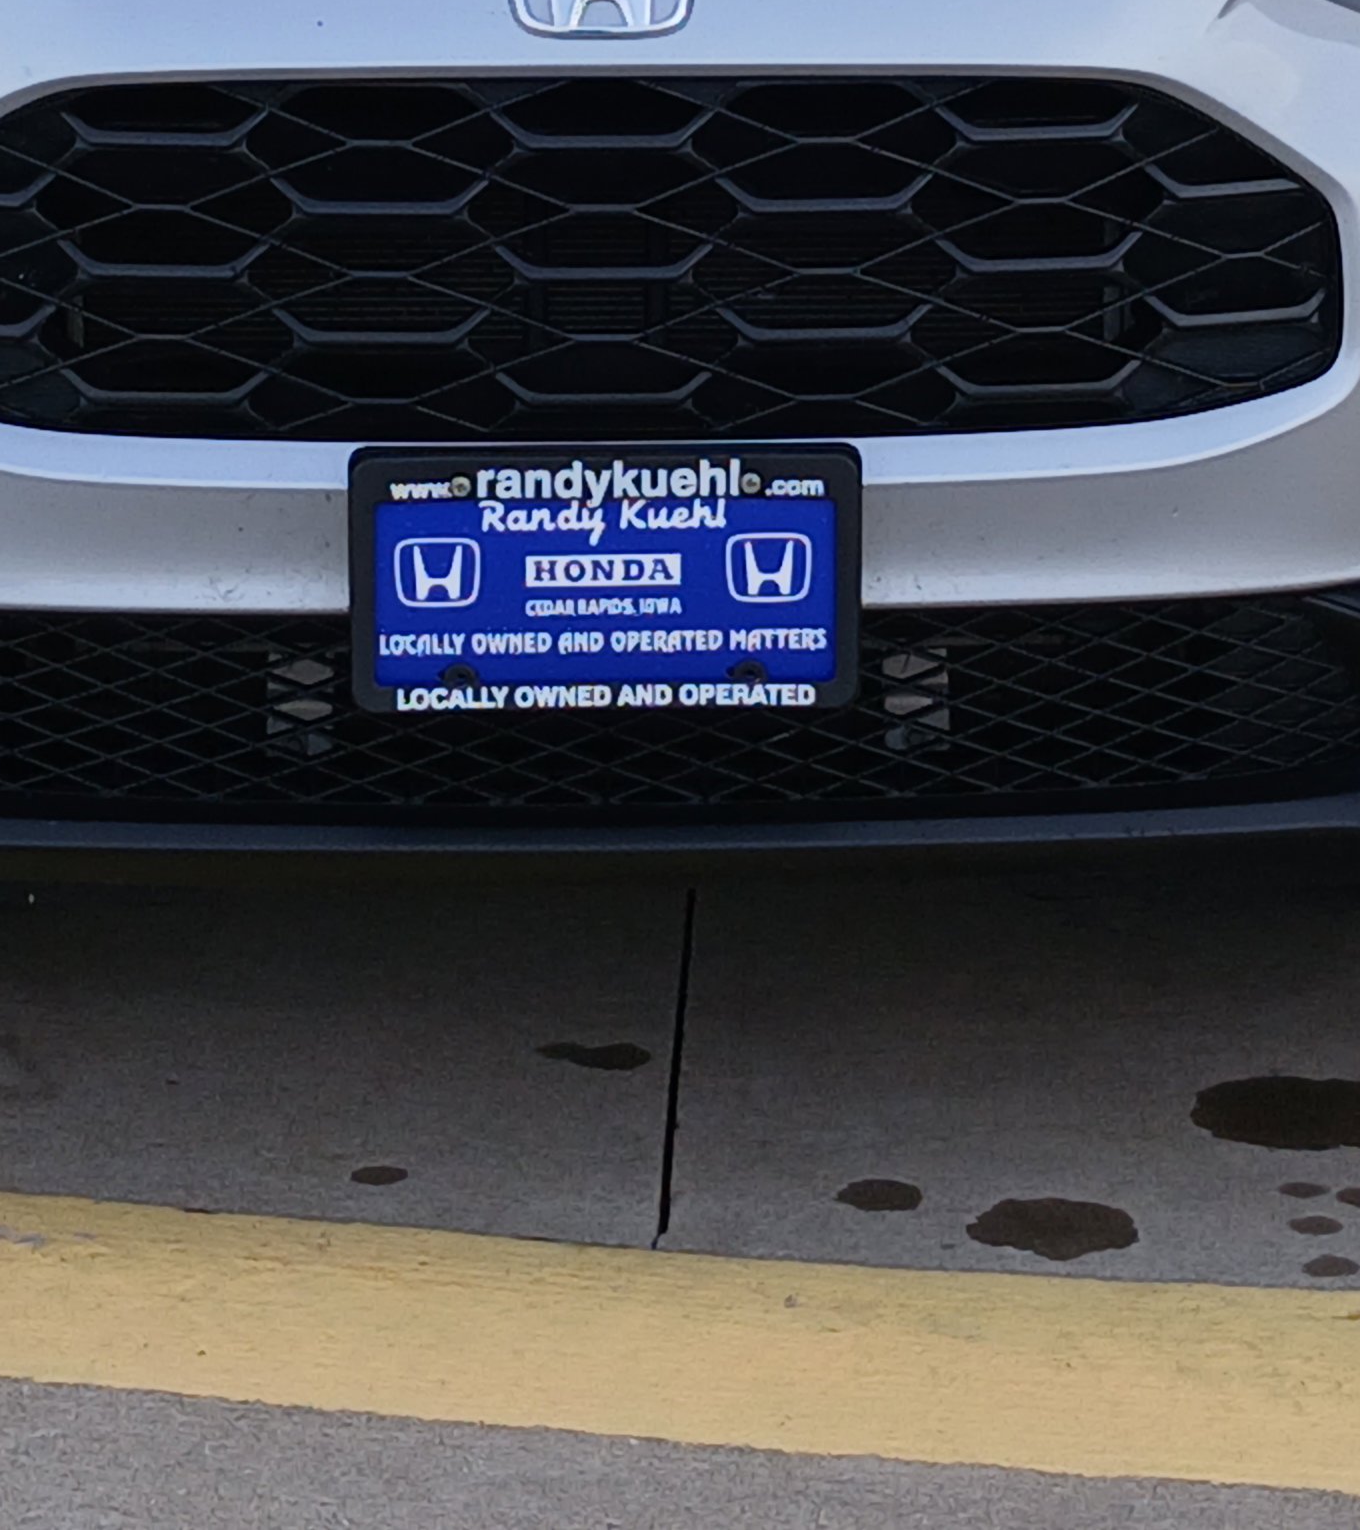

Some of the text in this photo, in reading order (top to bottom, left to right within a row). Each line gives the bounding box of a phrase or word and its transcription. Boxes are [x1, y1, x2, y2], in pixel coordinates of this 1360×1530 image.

[478, 498, 727, 546] Randy Kuehl
[534, 558, 674, 582] HONDA
[639, 596, 683, 615] IOWA
[379, 627, 828, 657] LOCALLY OWNED AND OPERATED MATTERS
[397, 682, 817, 711] LOCALLY OWNED AND OPERATED
